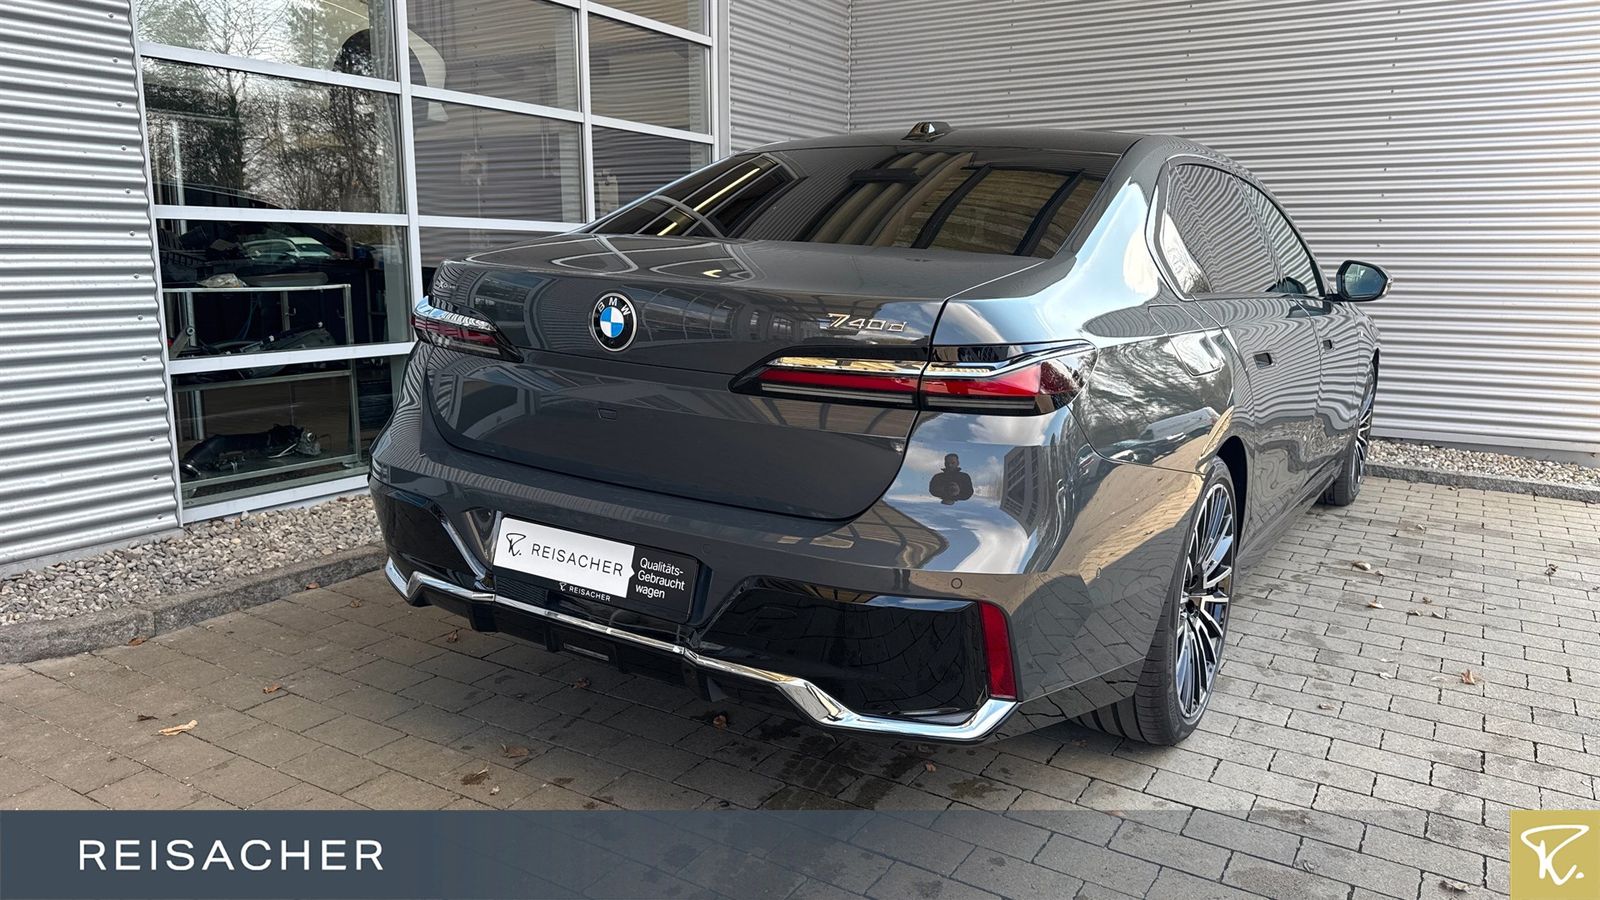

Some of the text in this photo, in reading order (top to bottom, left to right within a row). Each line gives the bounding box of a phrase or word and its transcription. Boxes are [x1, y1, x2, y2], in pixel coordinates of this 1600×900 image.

[597, 296, 631, 316] BMW
[531, 543, 624, 577] REISACHER
[640, 557, 684, 576] Qualitäts-
[637, 569, 686, 591] Gebraucht
[569, 585, 611, 601] REISACHER
[635, 584, 665, 599] wagen
